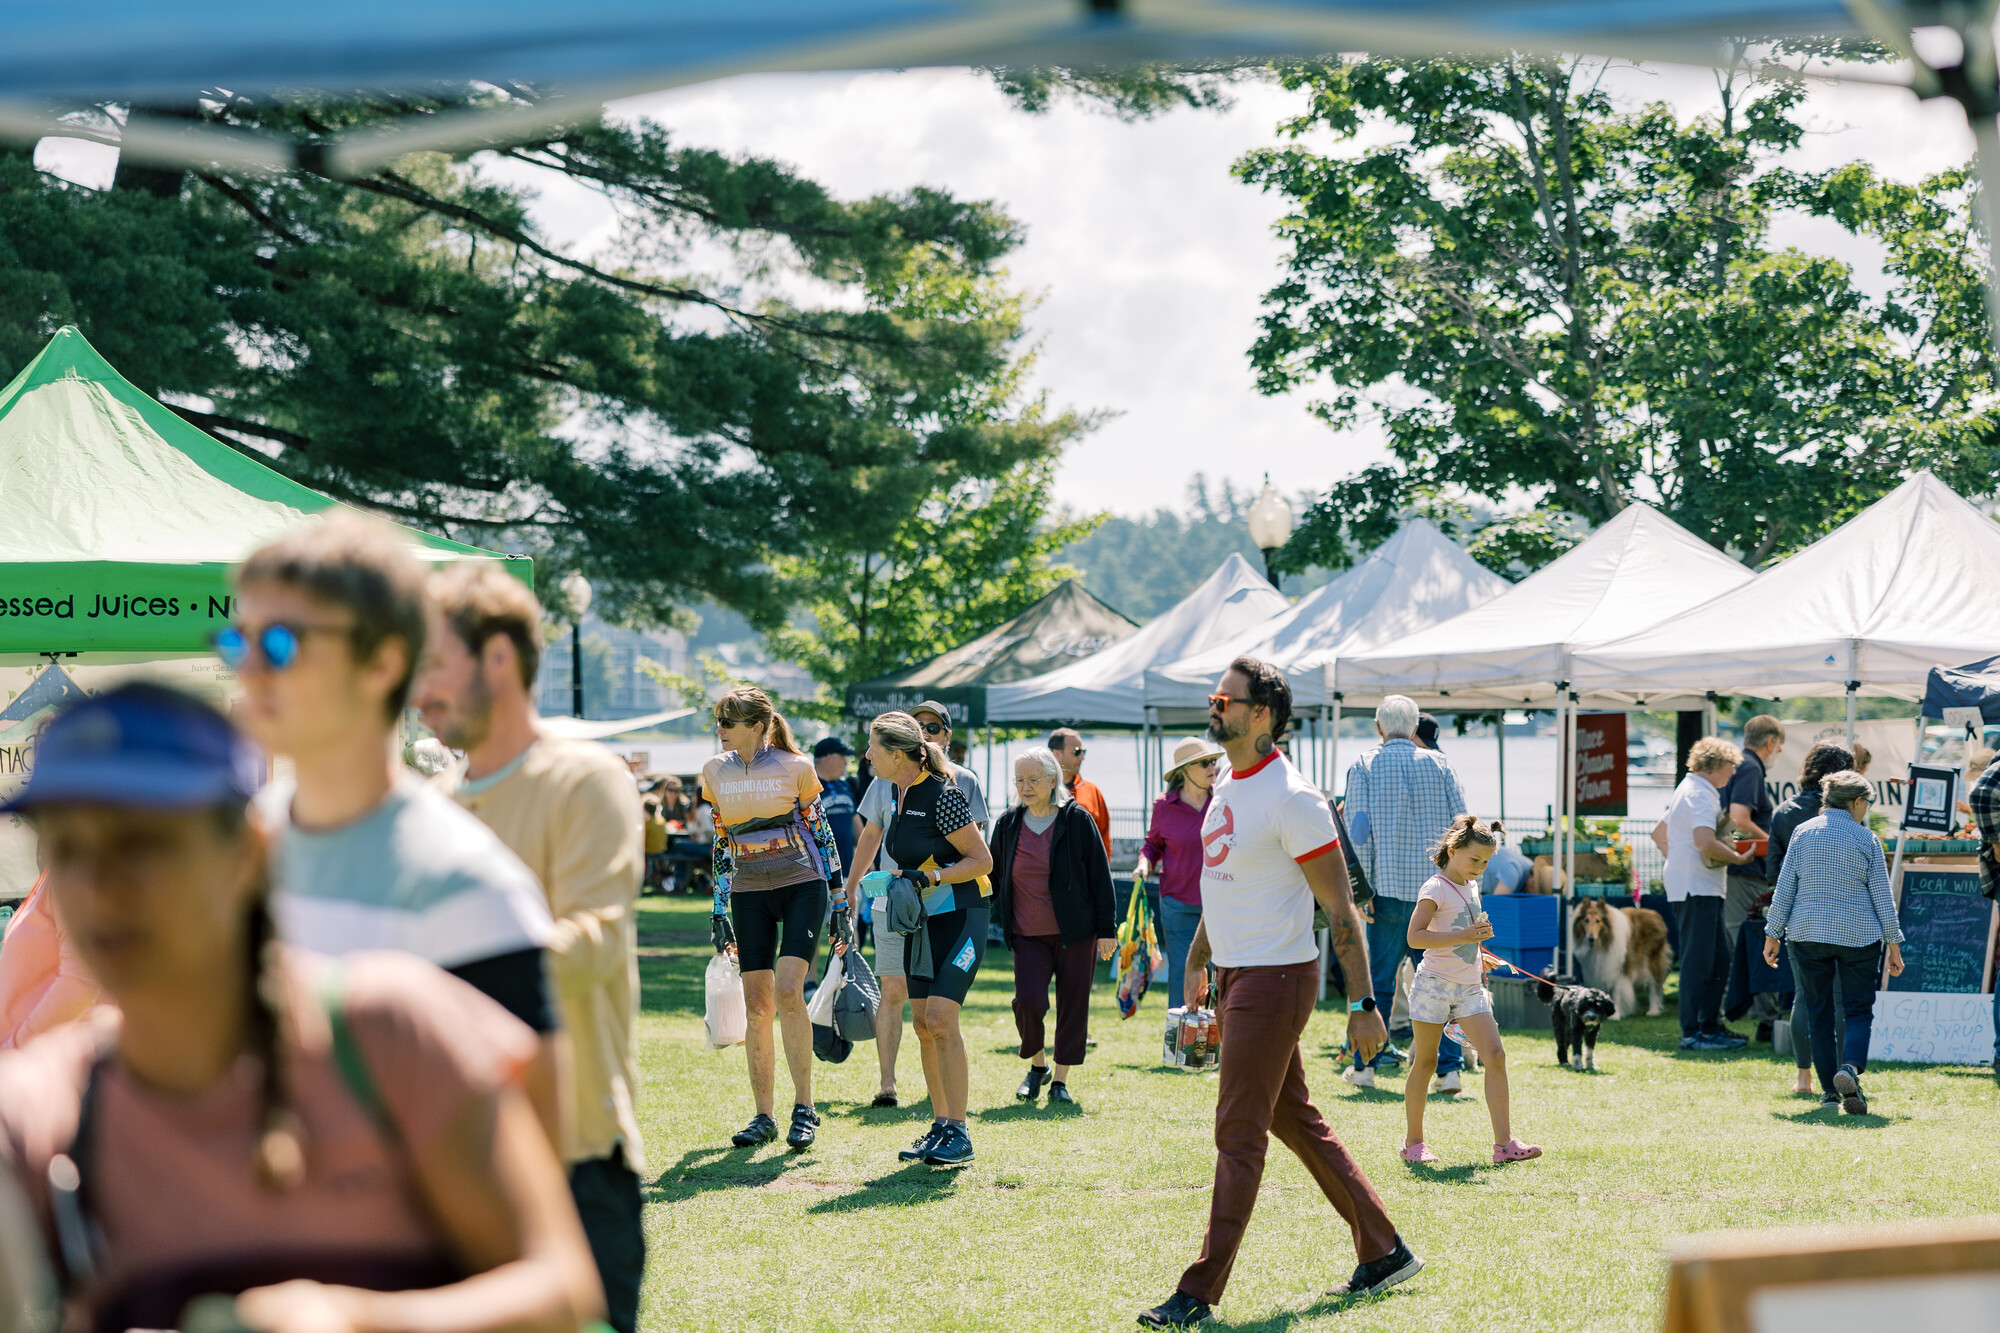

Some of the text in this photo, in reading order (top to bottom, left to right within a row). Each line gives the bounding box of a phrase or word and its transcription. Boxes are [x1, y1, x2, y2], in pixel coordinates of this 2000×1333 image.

[87, 594, 180, 618] Juices
[191, 664, 211, 673] Juice
[719, 779, 782, 795] ADIRONDACKS
[749, 791, 775, 800] YORK
[1910, 877, 1979, 893] LOCAL WIN
[956, 946, 975, 970] SAP
[1894, 998, 1992, 1026] GALLON
[1875, 1023, 1983, 1043] MAPLE SYRUP
[1906, 1040, 1935, 1062] 42
